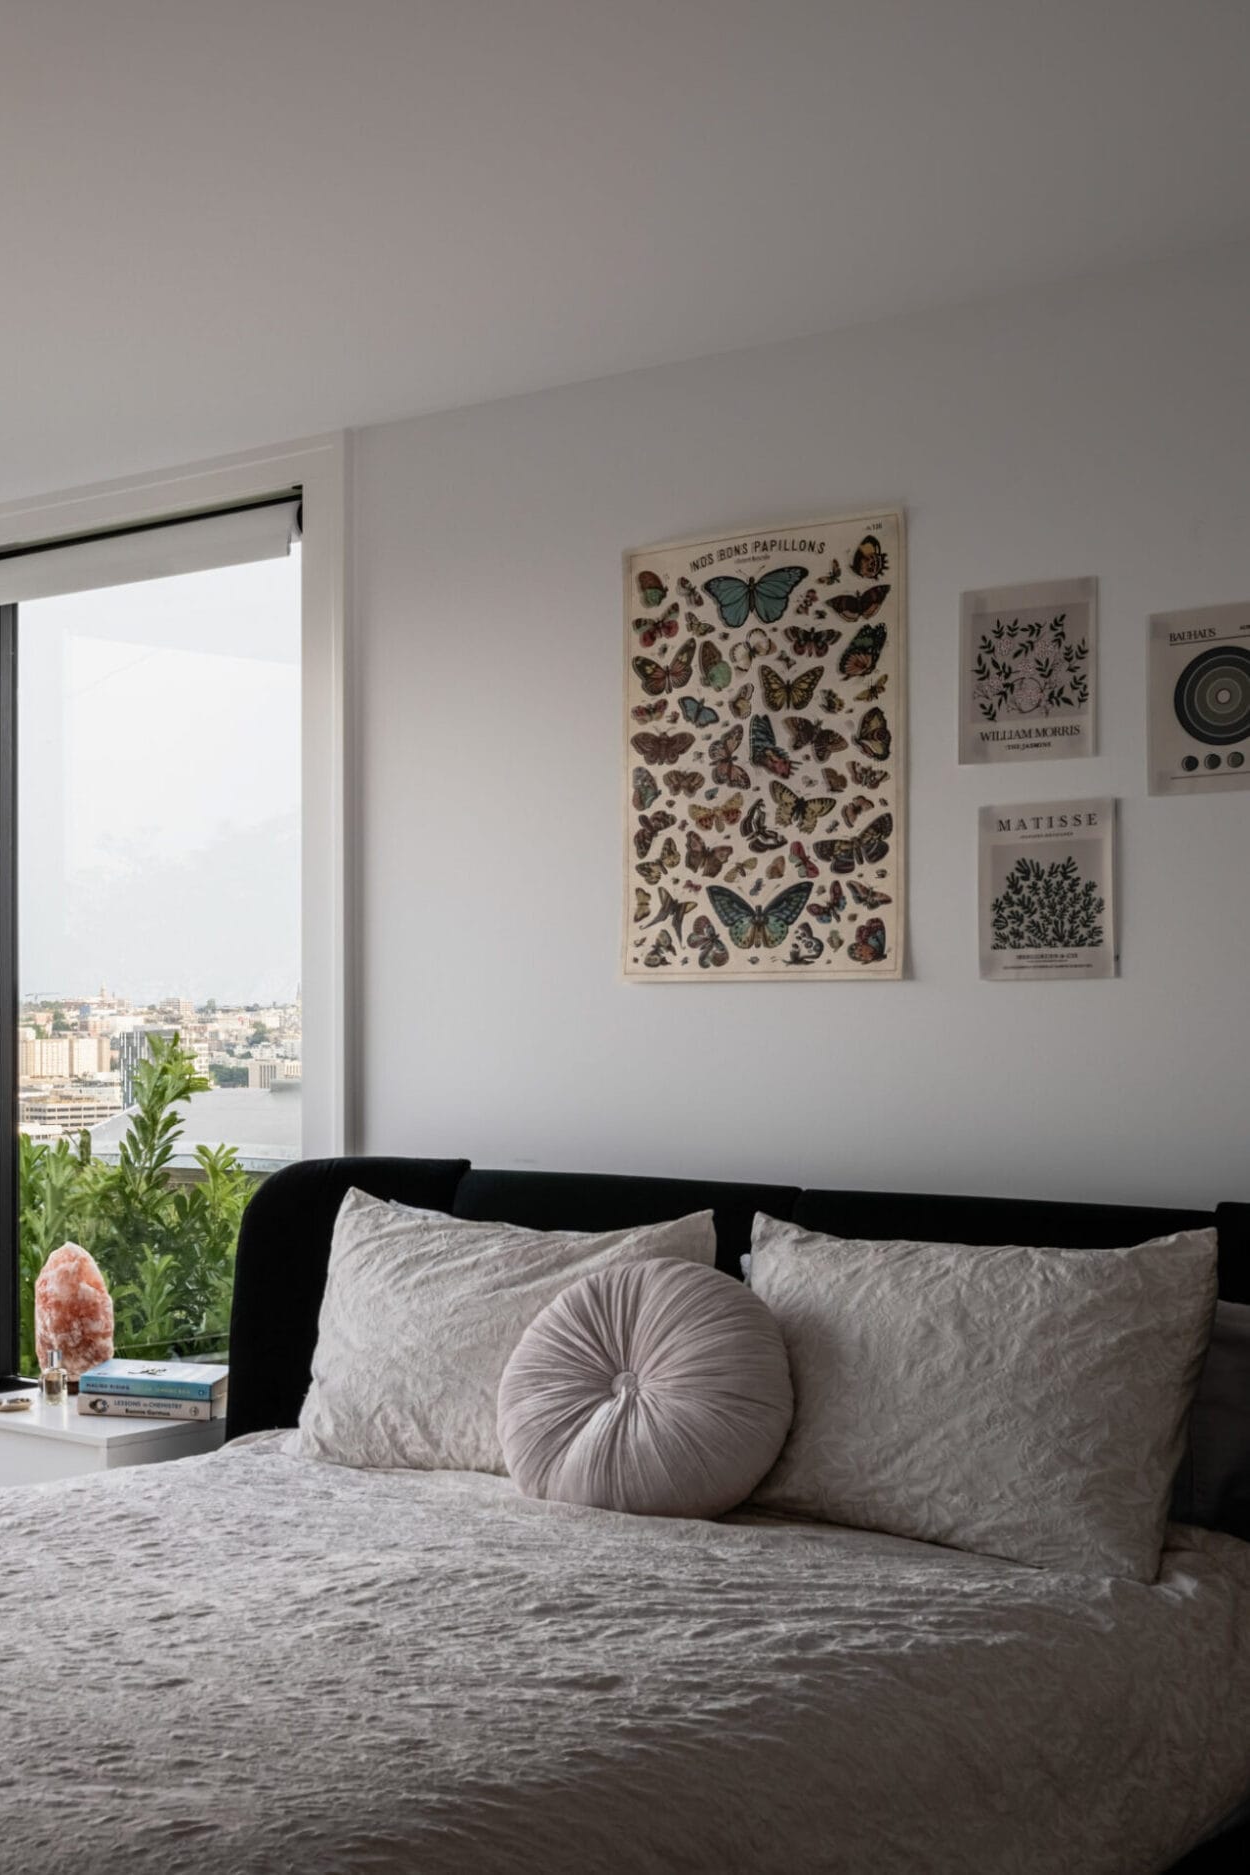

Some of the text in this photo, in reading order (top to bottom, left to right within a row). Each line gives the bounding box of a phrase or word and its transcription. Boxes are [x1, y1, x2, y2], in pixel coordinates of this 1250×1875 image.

[690, 553, 714, 572] NOS
[717, 543, 748, 560] BONS
[753, 539, 826, 554] PAPILLONS
[1169, 628, 1217, 642] BAUHAUS
[980, 725, 1081, 742] WILLIAM MORRIS
[997, 813, 1098, 832] MATISSE
[114, 1399, 141, 1407] LESSONS
